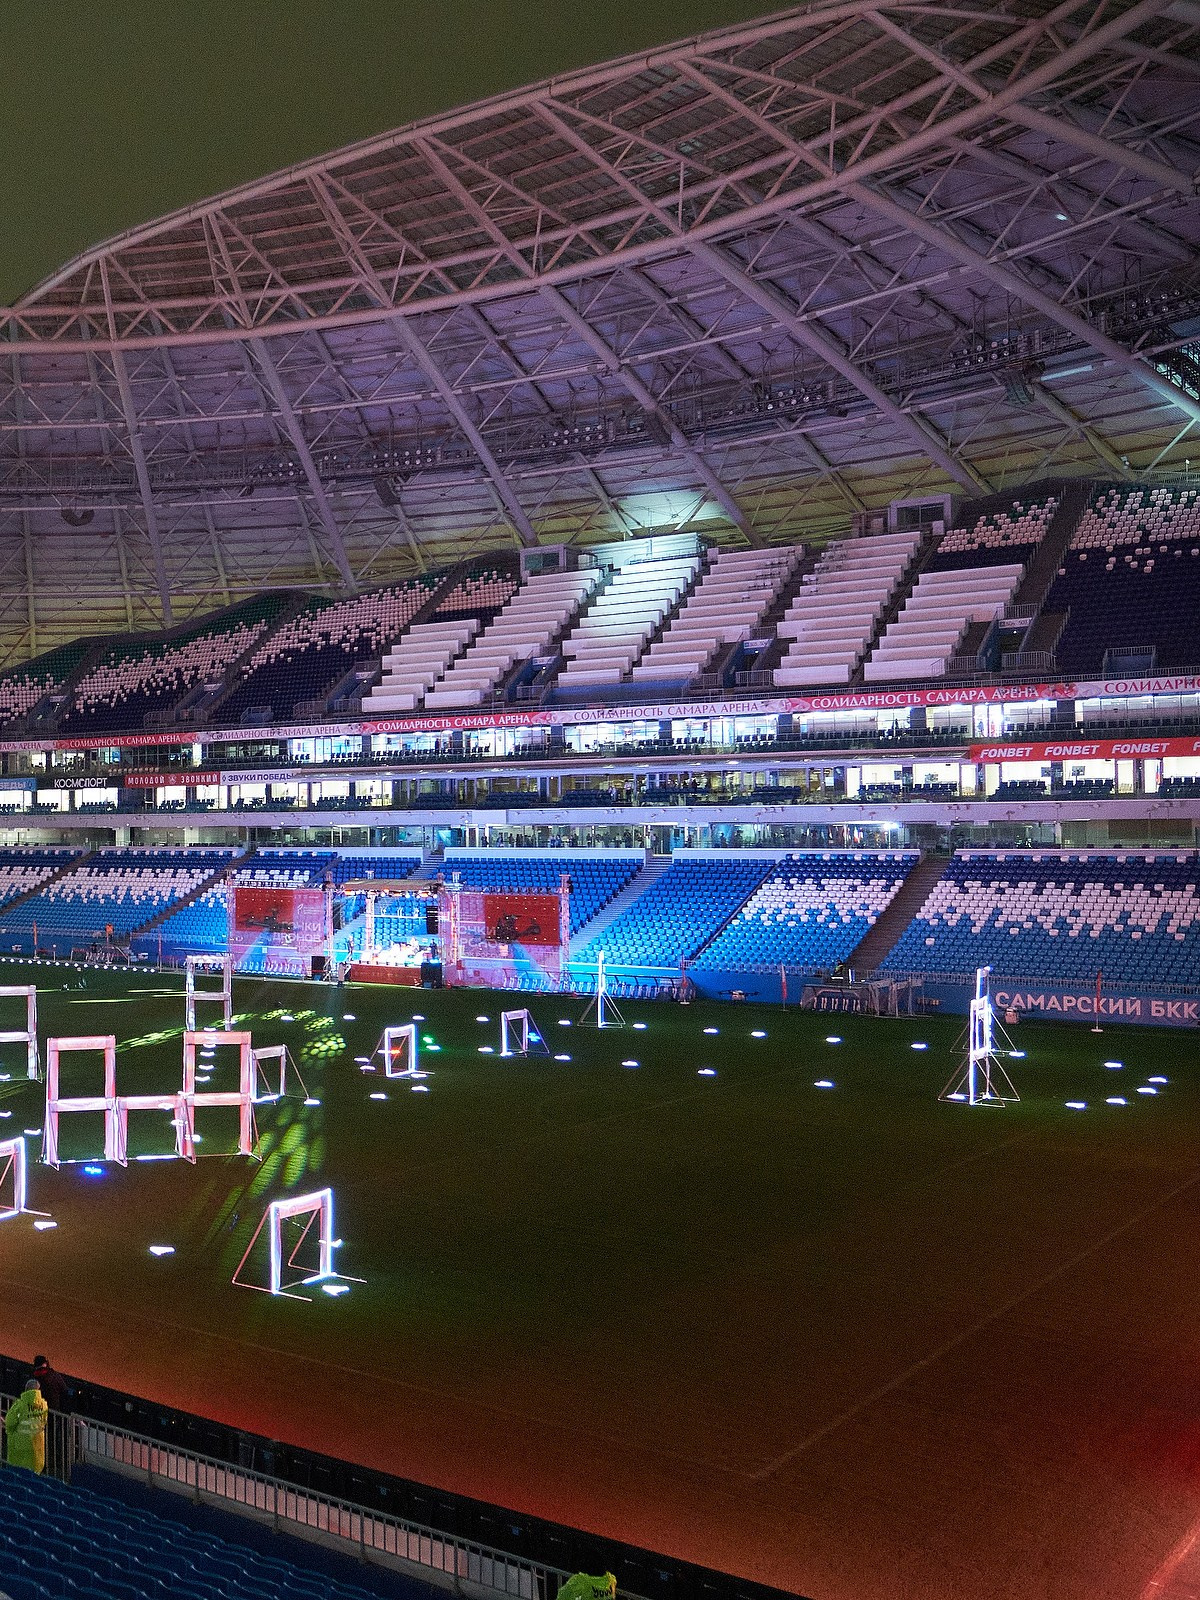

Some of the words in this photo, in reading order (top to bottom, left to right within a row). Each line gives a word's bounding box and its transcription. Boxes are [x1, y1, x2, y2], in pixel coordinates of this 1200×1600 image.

[1104, 676, 1200, 694] СОЛИДАРН
[811, 692, 921, 710] СОЛИДАРНОСТЬ
[926, 689, 987, 702] САМАРА
[991, 685, 1039, 699] АРЕНА
[574, 707, 663, 721] СОЛИДАРНОСТЬ
[667, 704, 717, 716] САМАРА
[720, 702, 759, 713] АРЕНА
[376, 719, 451, 731] СОЛИДАРНОСТЬ
[454, 716, 495, 727] САМАРА
[498, 714, 531, 725] АРЕНА
[211, 728, 276, 740] СОЛИДАРНОСТЬ
[278, 726, 312, 737] САМАРА
[314, 725, 341, 735] АРЕНА
[18, 741, 42, 750] АРЕНА
[70, 737, 125, 748] СОЛИДАРНОСТЬ
[126, 736, 156, 745] САМАРА
[158, 734, 181, 744] АРЕНА
[979, 746, 1033, 759] FONBET
[1044, 744, 1100, 756] FONBET
[1111, 742, 1170, 754] FONBET
[128, 776, 165, 785] МОЛОДОЙ
[181, 773, 218, 783] ЗВОНКИЙ
[257, 773, 294, 781] ПОБЕДЫ
[457, 925, 496, 935] ОНКИ
[995, 991, 1141, 1016] САМАРСКИЙ
[1151, 1000, 1198, 1019] БКК
